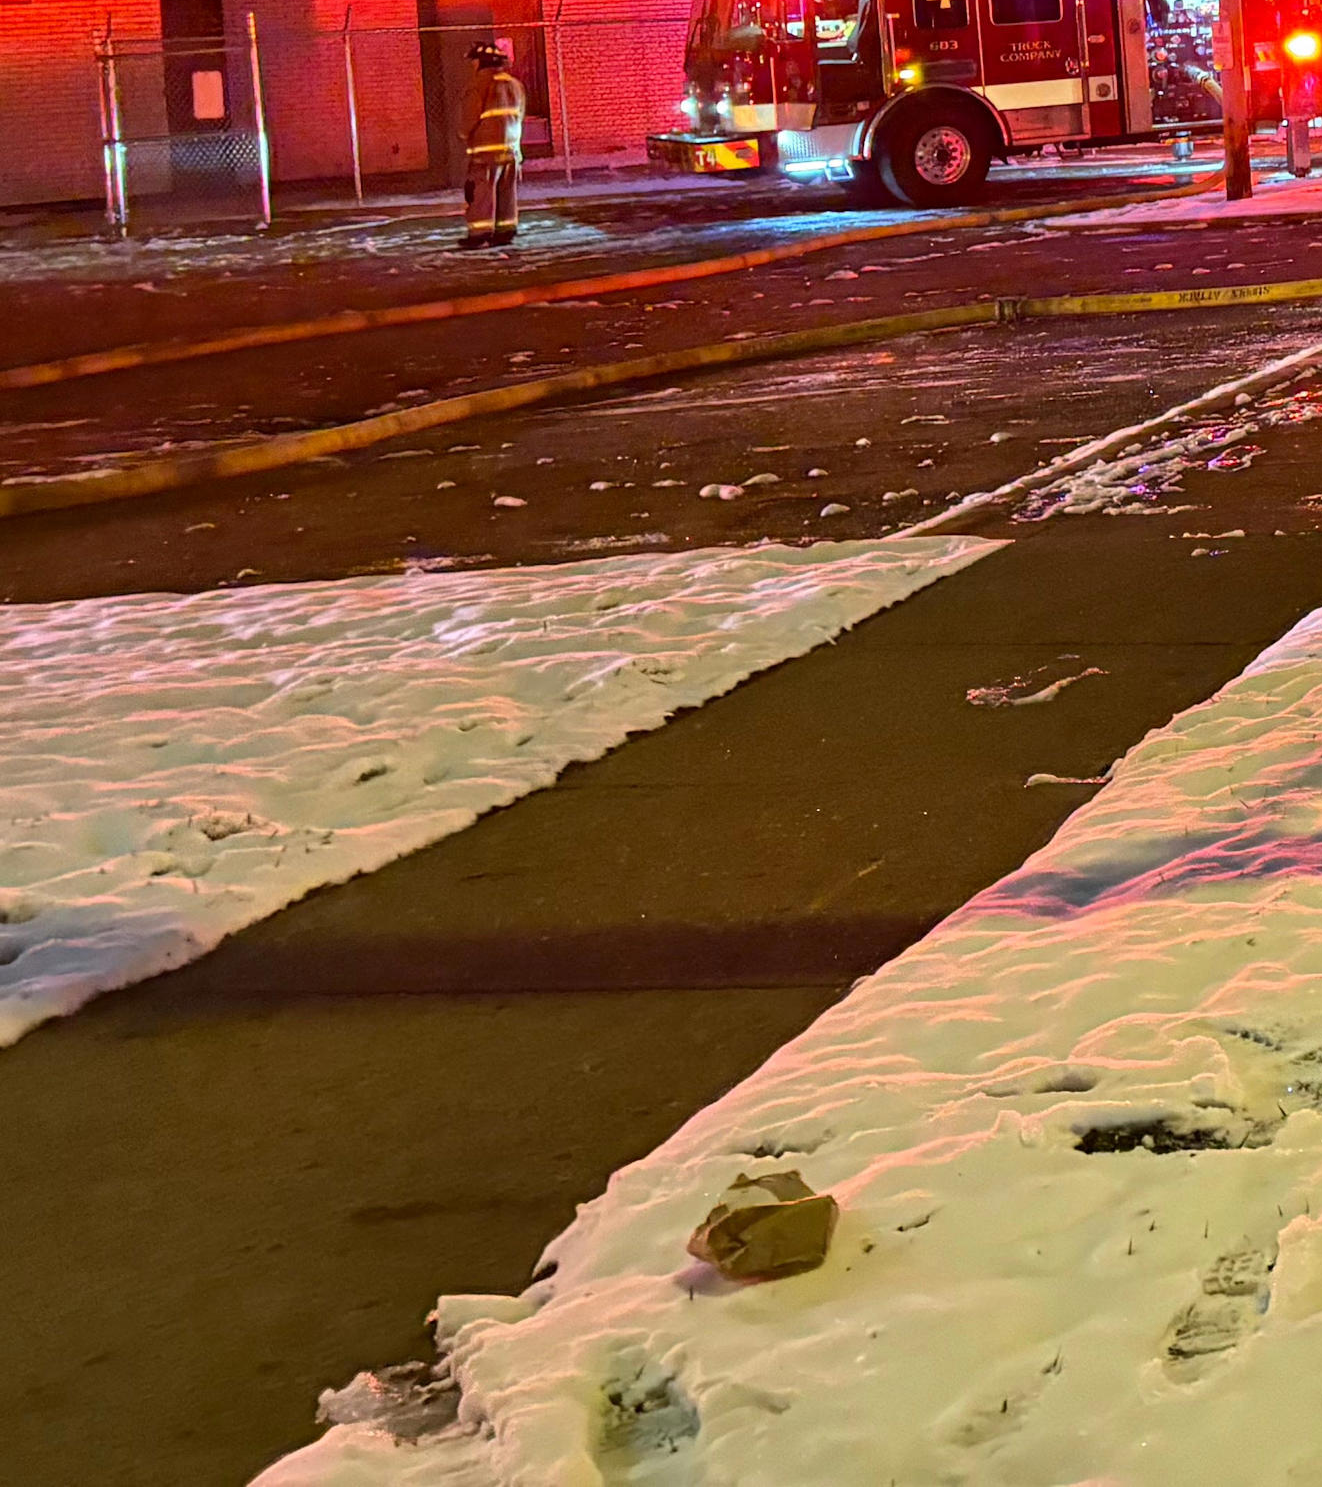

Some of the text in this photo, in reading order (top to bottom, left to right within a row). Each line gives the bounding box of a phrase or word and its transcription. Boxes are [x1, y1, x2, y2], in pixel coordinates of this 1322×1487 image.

[1010, 40, 1052, 52] TRUCK
[1000, 50, 1062, 63] COMPANY
[695, 150, 716, 167] T4
